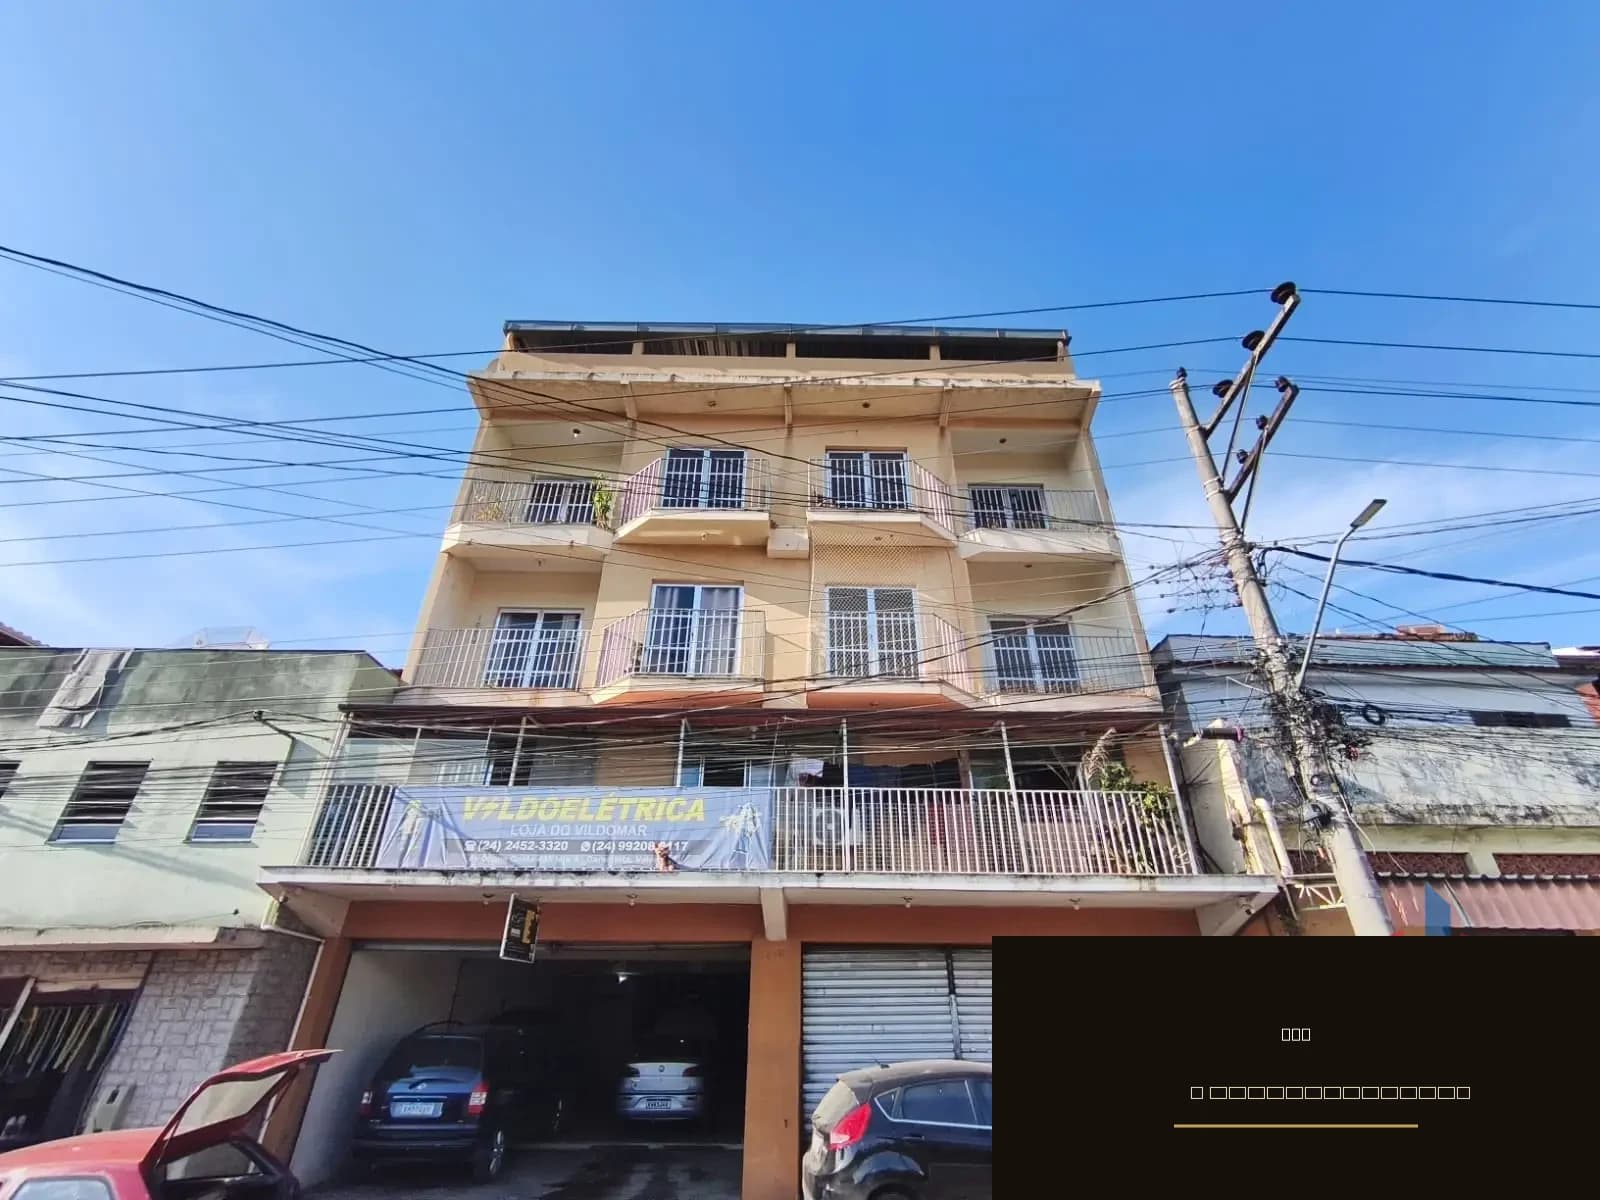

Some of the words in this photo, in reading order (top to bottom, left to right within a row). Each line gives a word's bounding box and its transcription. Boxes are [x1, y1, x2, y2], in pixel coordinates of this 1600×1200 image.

[510, 824, 546, 837] LOJA
[550, 824, 571, 837] DO
[575, 824, 648, 837] VILDOMAR
[478, 840, 501, 852] (24)
[504, 840, 568, 851] 2452-3320
[592, 841, 616, 853] (24)
